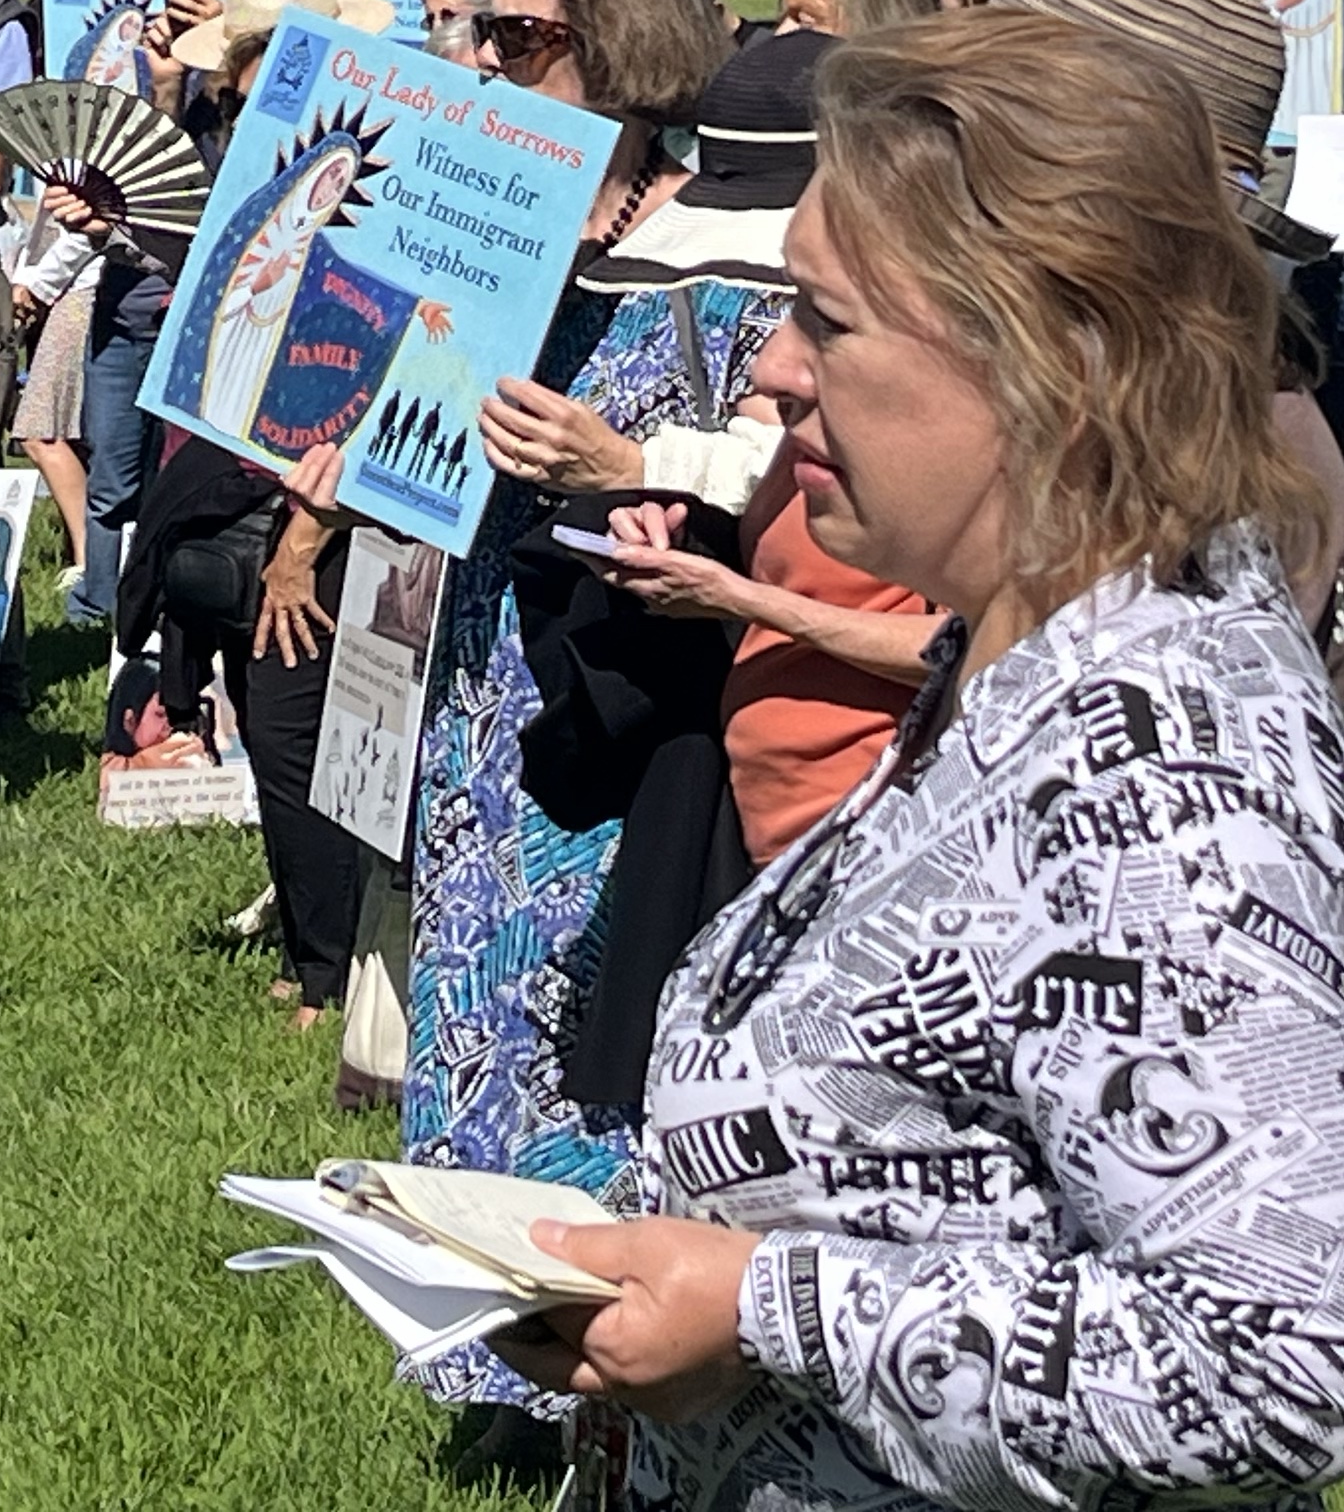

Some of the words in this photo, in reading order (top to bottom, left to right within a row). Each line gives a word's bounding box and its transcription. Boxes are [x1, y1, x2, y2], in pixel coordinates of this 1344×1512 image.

[331, 49, 376, 89] Our
[379, 67, 440, 121] Lady
[444, 100, 474, 126] of
[479, 109, 585, 169] Sorrows
[415, 136, 502, 197] Witness
[503, 173, 540, 211] for
[382, 175, 424, 211] Our
[425, 190, 546, 261] Immigrant
[388, 225, 502, 293] Neighbors
[323, 272, 387, 334] DIGNITY
[288, 342, 363, 372] FAMILY
[257, 383, 371, 449] SOLIDARITY
[666, 1113, 765, 1191] CHIC
[1140, 1144, 1262, 1237] ADVERTISEMENT
